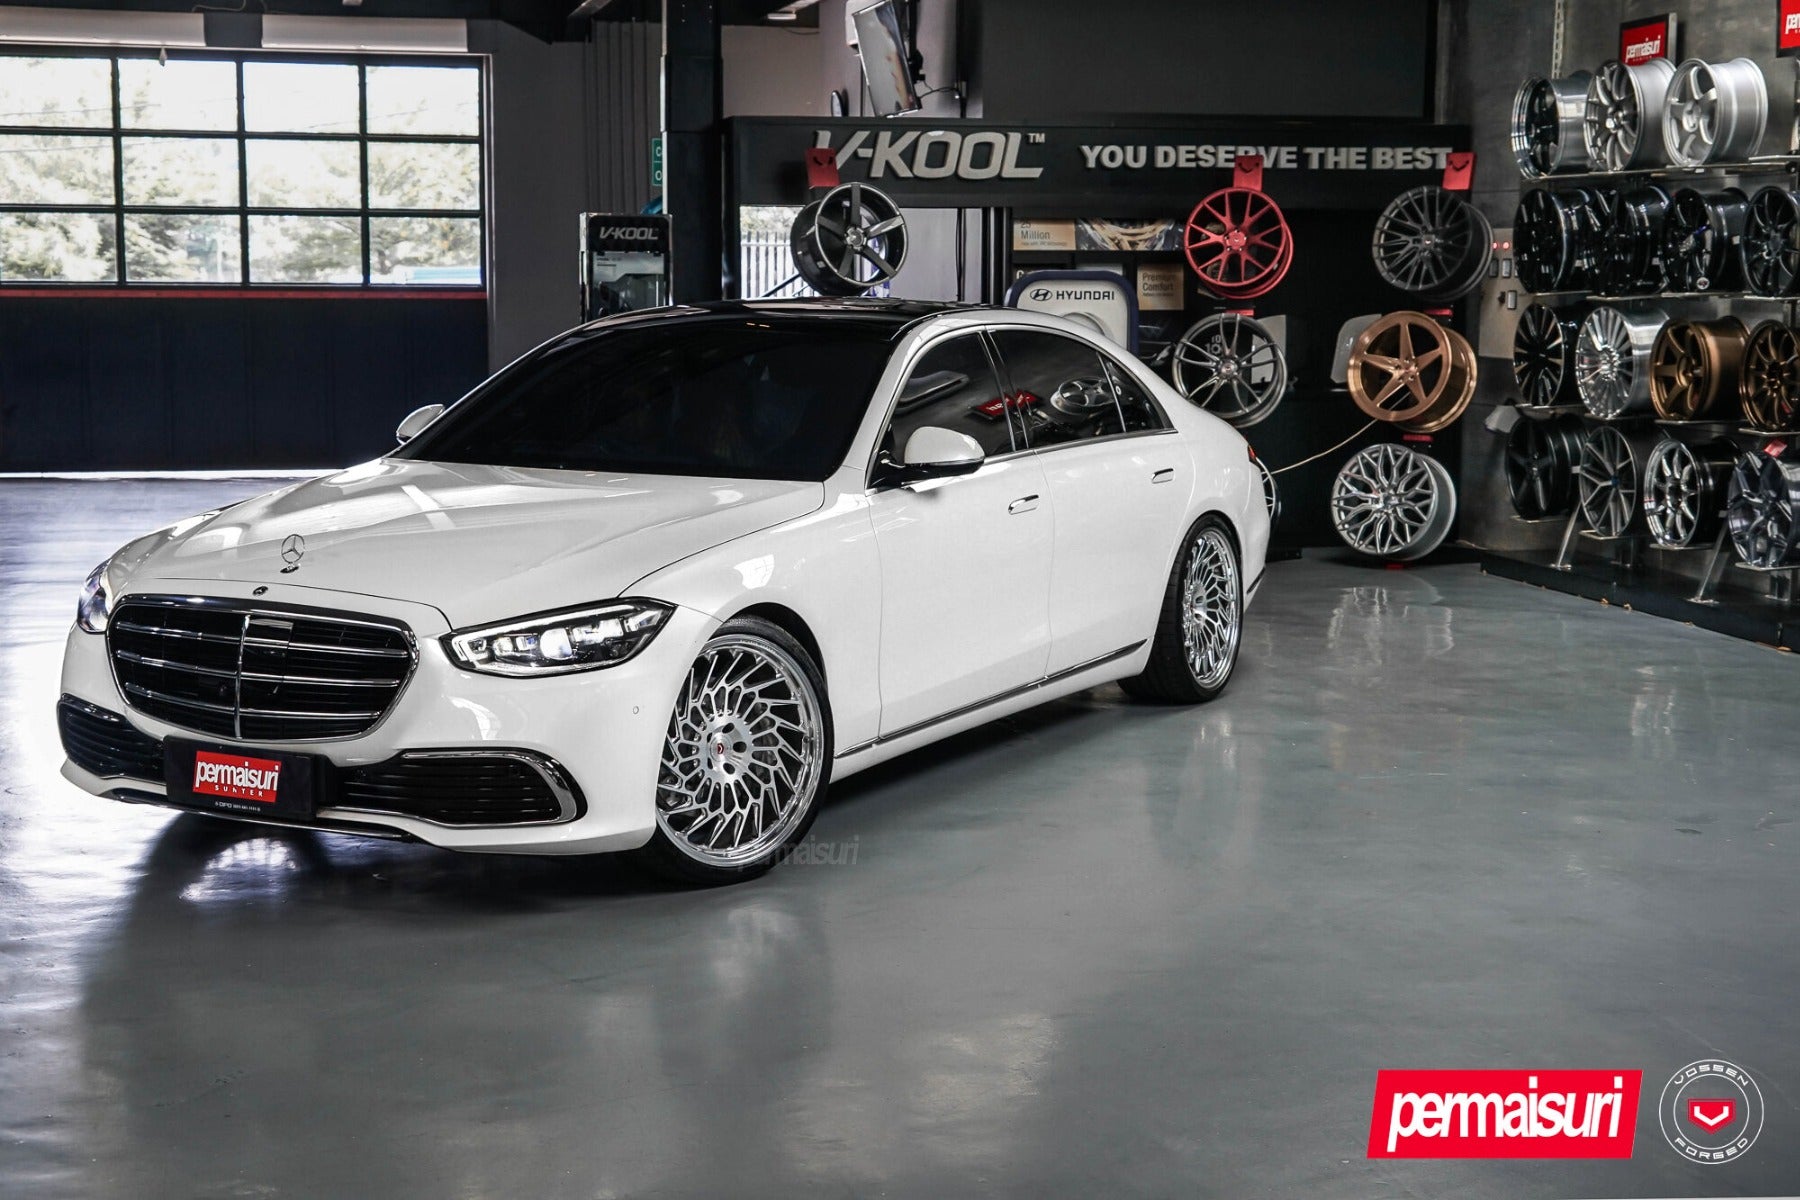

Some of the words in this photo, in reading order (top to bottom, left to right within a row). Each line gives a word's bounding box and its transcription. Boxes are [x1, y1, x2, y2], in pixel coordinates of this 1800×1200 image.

[1080, 144, 1148, 169] YOU
[1303, 146, 1367, 170] THE
[1371, 146, 1453, 170] BEST
[599, 226, 659, 241] V-KOOL
[1021, 230, 1051, 241] Million
[1056, 290, 1115, 300] HYUNDAI
[196, 761, 279, 791] permaisuri
[214, 784, 263, 797] SUNTER
